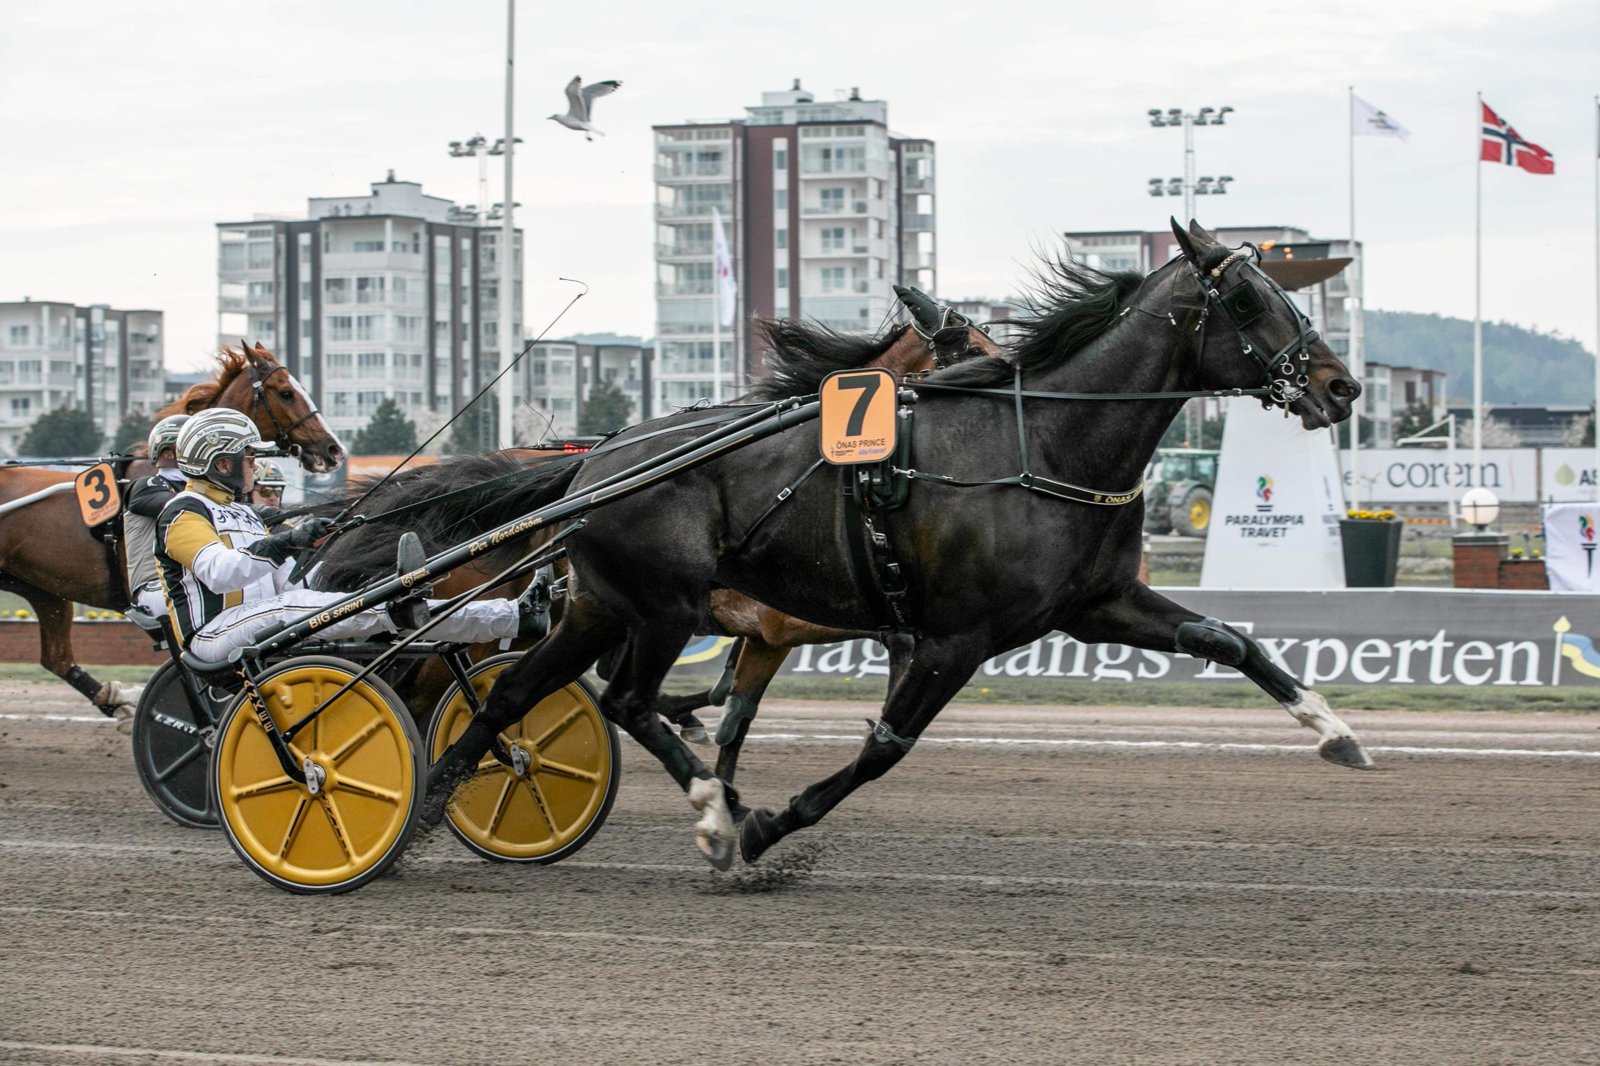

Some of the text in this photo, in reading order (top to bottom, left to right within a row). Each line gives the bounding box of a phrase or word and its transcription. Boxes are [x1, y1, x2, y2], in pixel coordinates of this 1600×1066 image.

[838, 374, 881, 437] 7
[84, 469, 110, 509] 3
[1387, 462, 1502, 488] corem
[1225, 514, 1304, 525] PARALYMPIA
[1240, 527, 1288, 537] TRAVET
[309, 598, 364, 629] BIG SPRINT
[236, 667, 274, 733] YANKEE
